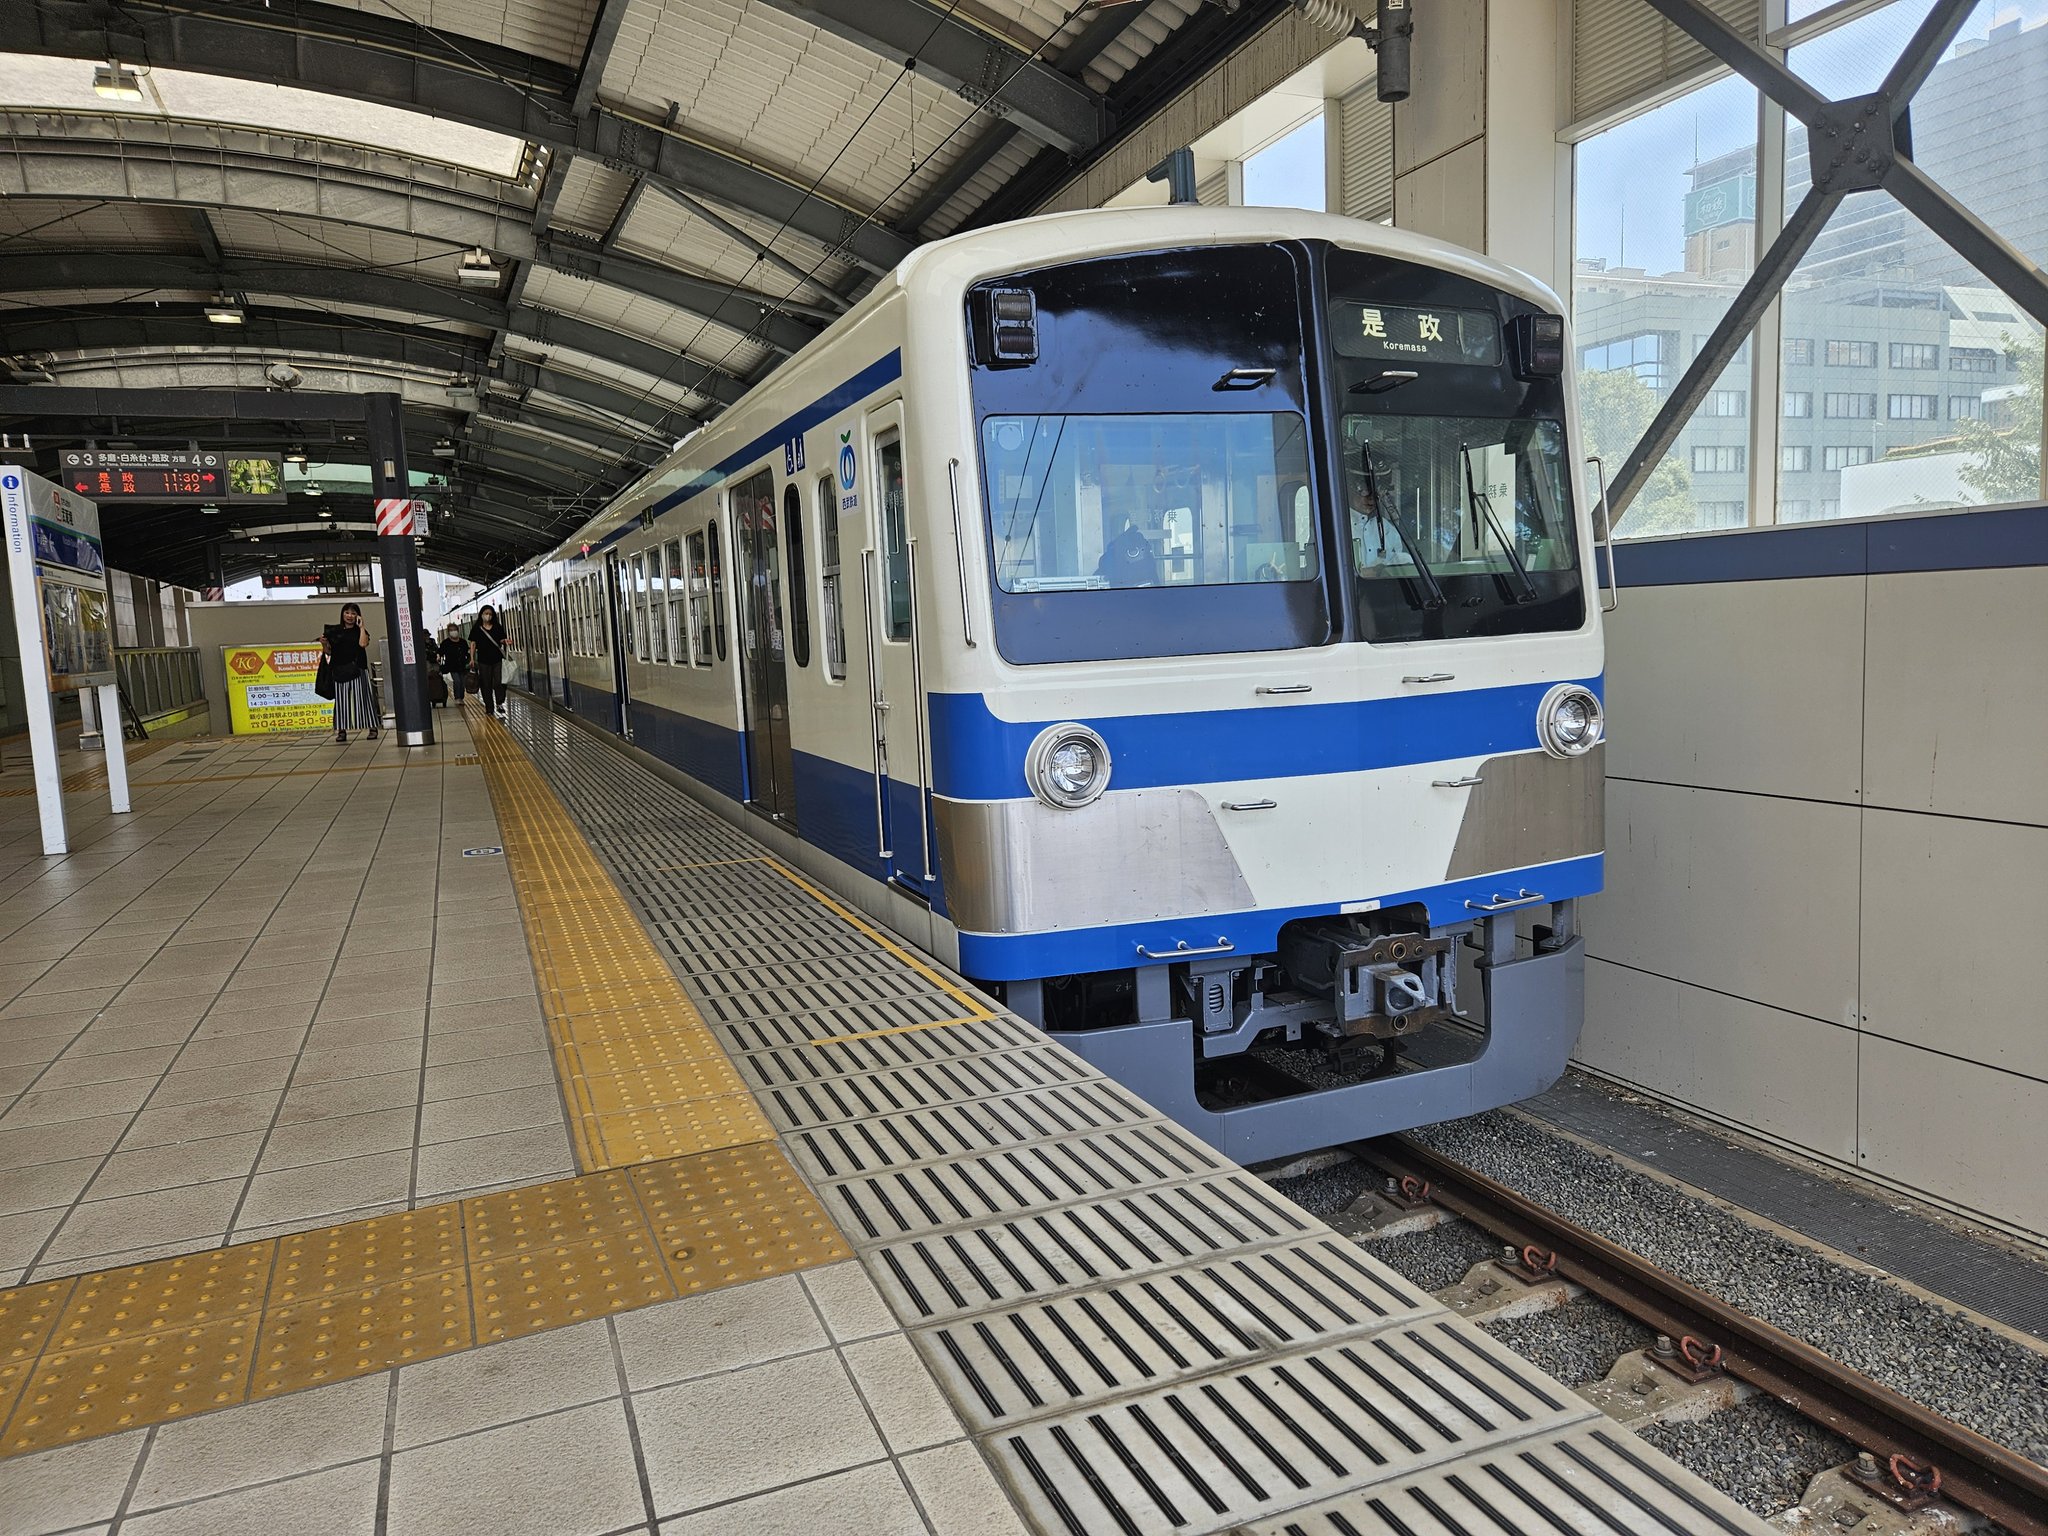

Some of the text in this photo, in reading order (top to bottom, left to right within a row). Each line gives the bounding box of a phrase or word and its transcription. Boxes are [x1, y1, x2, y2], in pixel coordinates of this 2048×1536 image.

[1362, 308, 1443, 341] 是政
[1383, 341, 1427, 352] Koremasa
[83, 454, 93, 466] 3
[191, 454, 201, 467] 4
[163, 473, 199, 482] 11:30
[164, 483, 200, 492] 11:42
[8, 493, 22, 553] Information
[235, 657, 257, 670] KC
